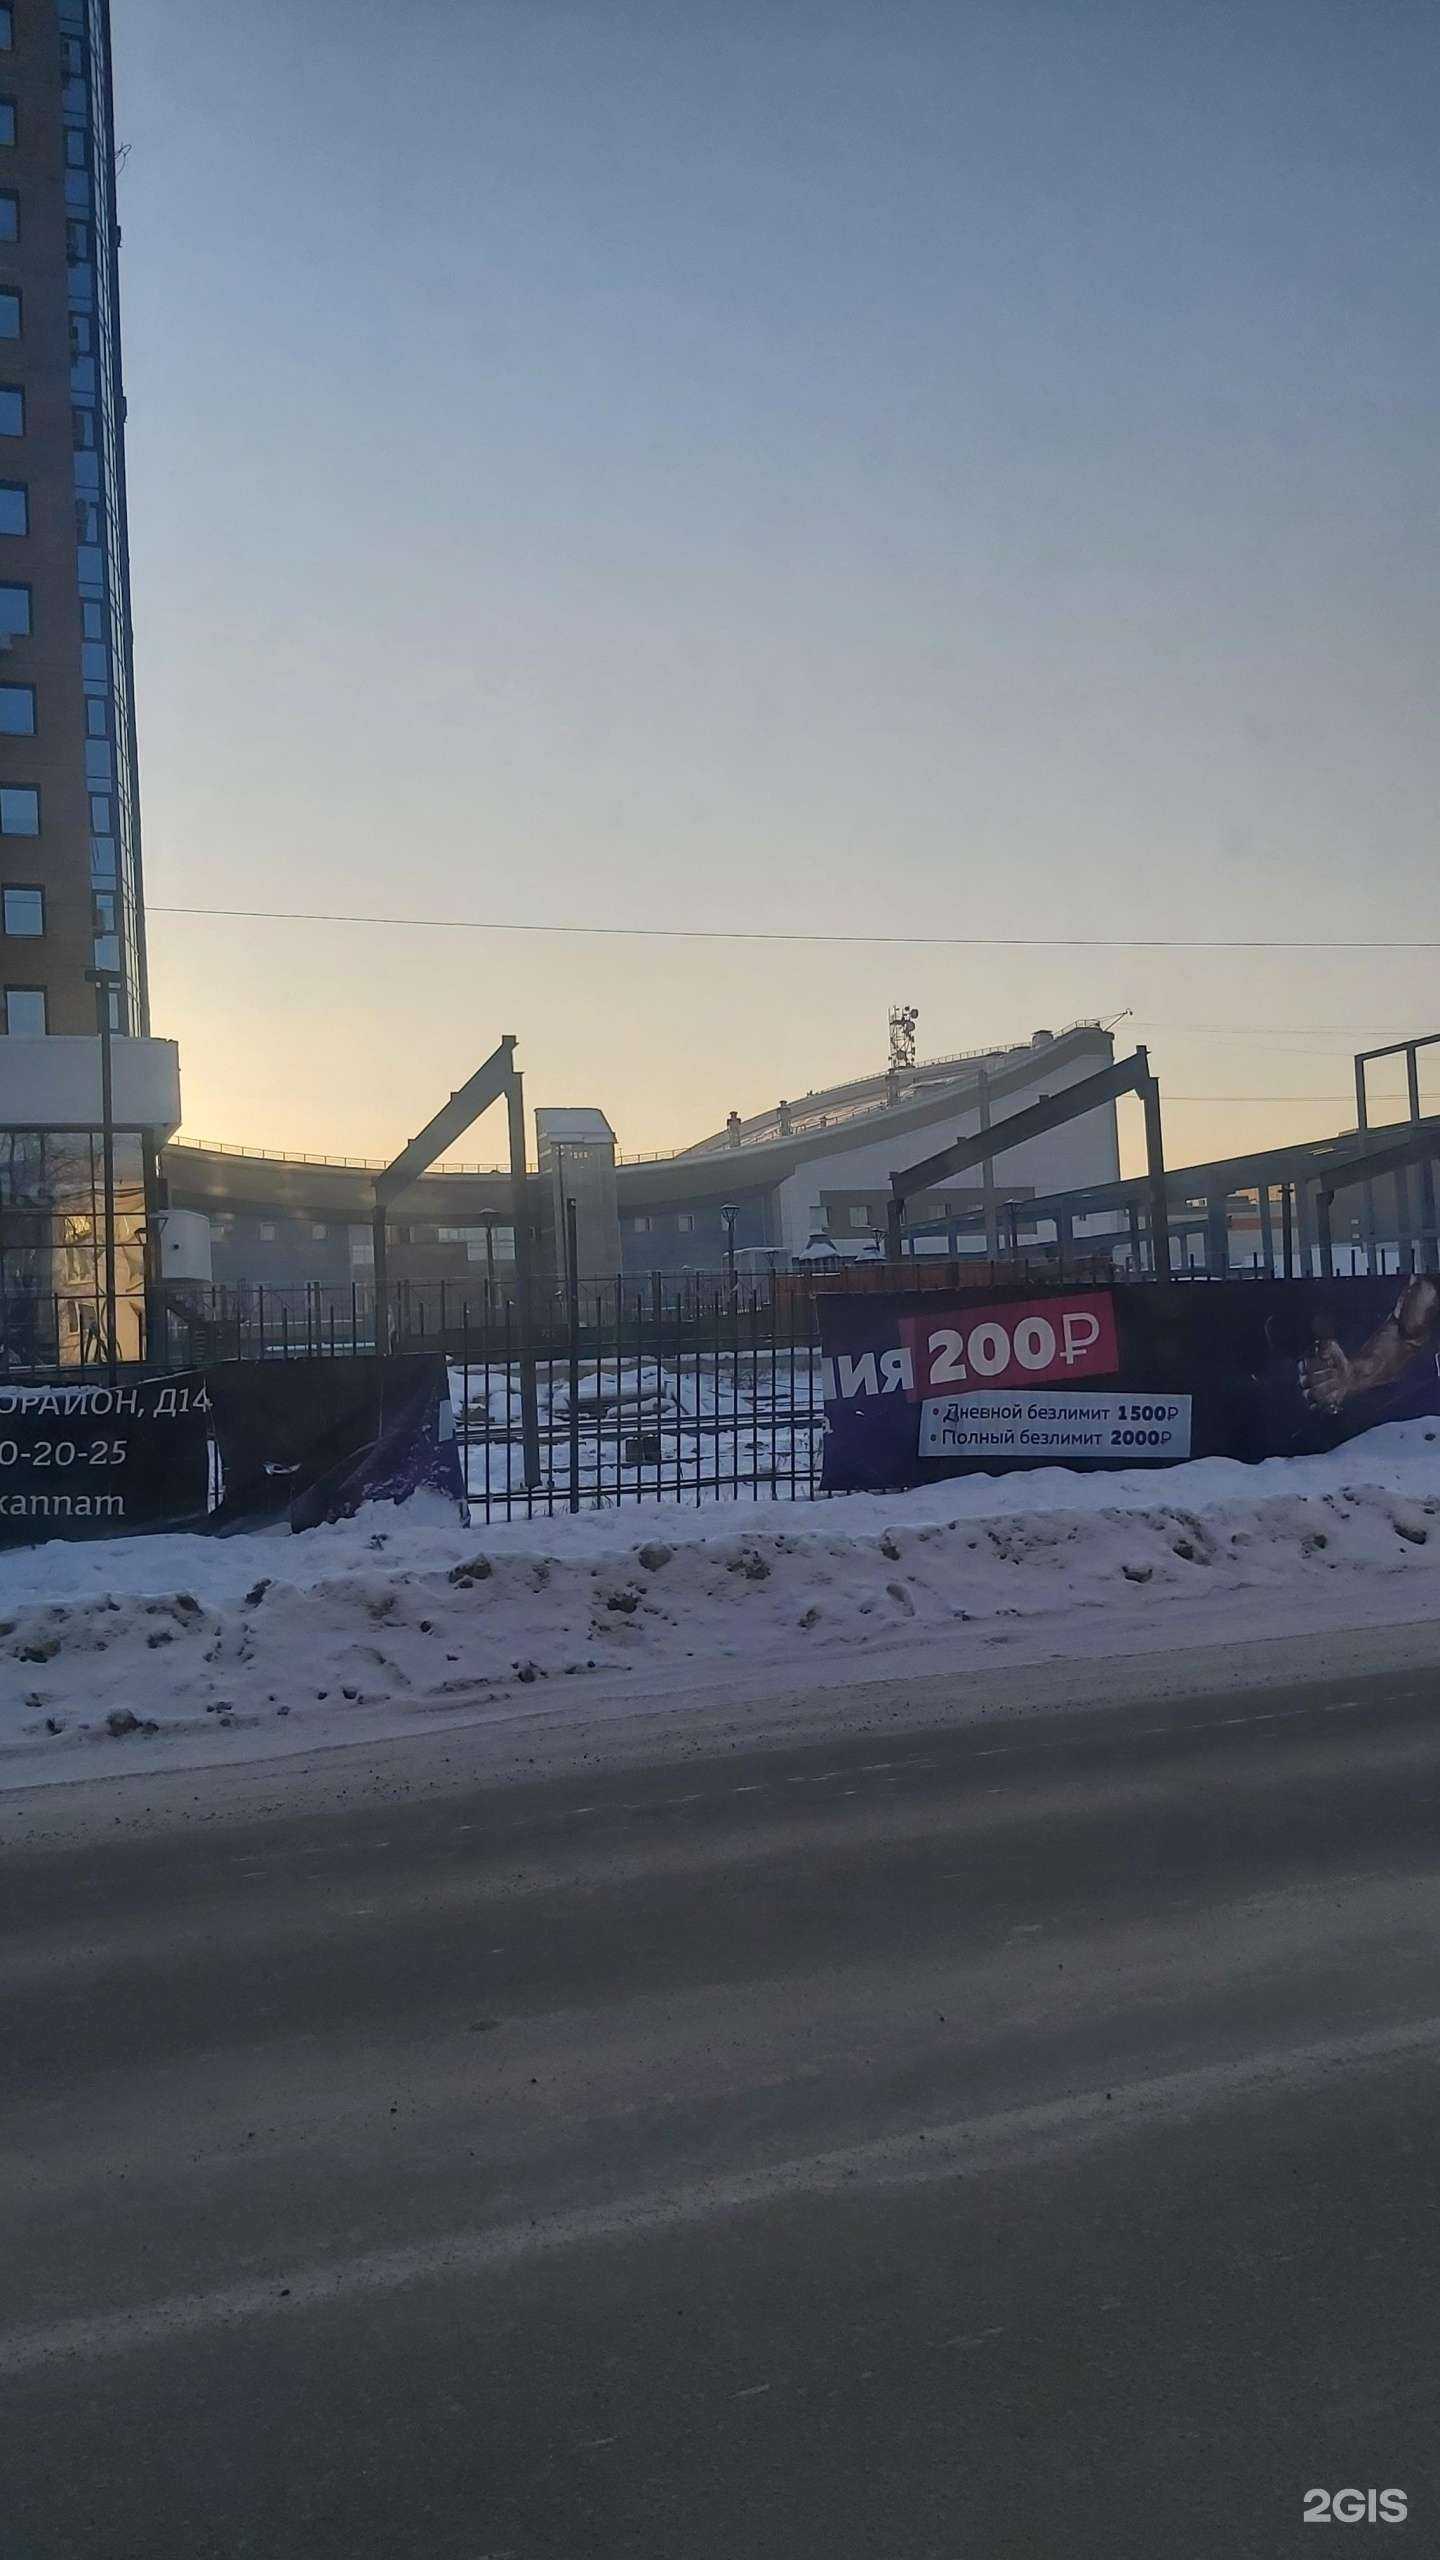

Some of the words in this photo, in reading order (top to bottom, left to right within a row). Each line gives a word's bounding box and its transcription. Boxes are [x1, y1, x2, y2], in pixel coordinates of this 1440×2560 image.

[927, 1312, 1101, 1386] 200₽
[153, 1386, 213, 1418] Д14
[943, 1403, 1022, 1424] Дневной
[1027, 1403, 1110, 1421] безлимит
[942, 1429, 1015, 1446] Полный
[1020, 1429, 1103, 1446] безлимит
[0, 1440, 128, 1466] 0-20-25
